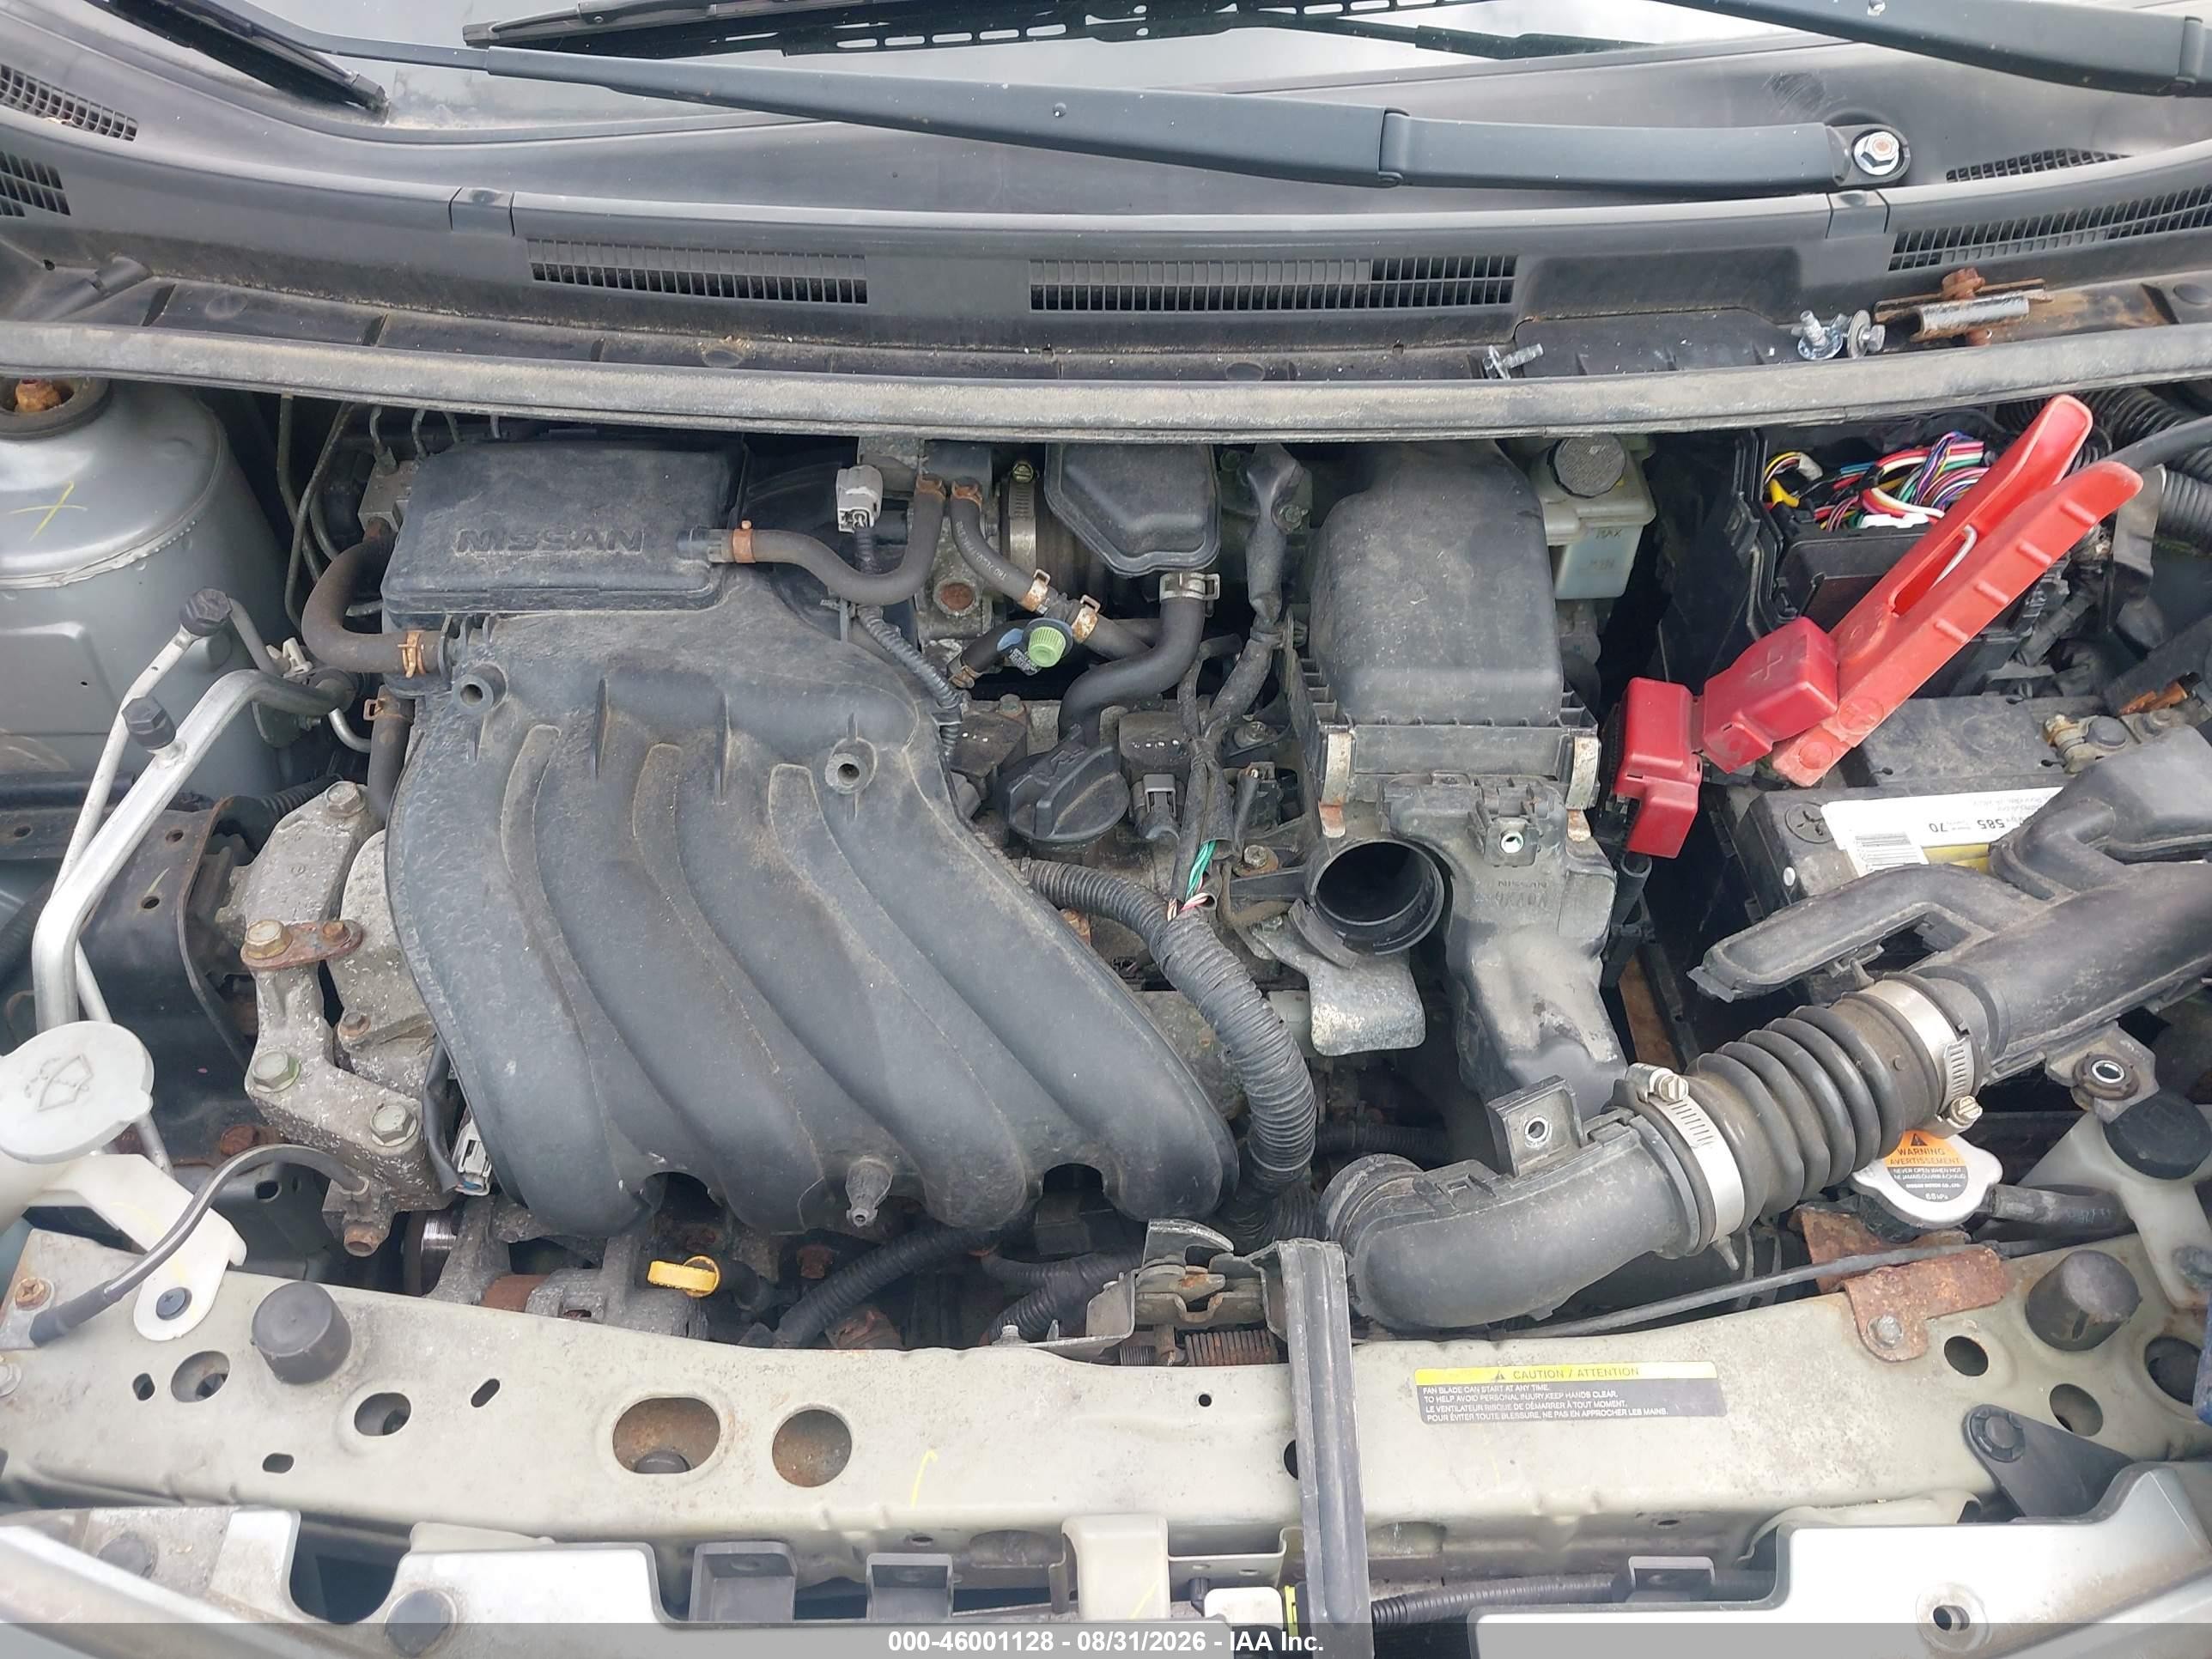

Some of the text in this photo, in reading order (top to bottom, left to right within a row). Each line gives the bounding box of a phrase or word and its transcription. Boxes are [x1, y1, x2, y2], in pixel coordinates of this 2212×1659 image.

[453, 528, 644, 556] NISSAN
[1929, 823, 1948, 833] 70
[1978, 818, 2006, 830] 585
[1897, 1147, 1945, 1156] WARNING
[1513, 1370, 1564, 1380] CAUTION
[1577, 1368, 1639, 1377] ATTENTION
[1423, 1386, 1437, 1395] FAN
[1436, 1404, 1483, 1413] VENTILATEUR
[1483, 1403, 1511, 1412] RISQUE
[1525, 1401, 1567, 1410] DÉMARRER
[1450, 1413, 1474, 1421] ÉVITER
[1476, 1413, 1500, 1421] TOUTE
[1502, 1412, 1541, 1420] BLESSURE,
[1582, 1408, 1627, 1417] APPROCHER
